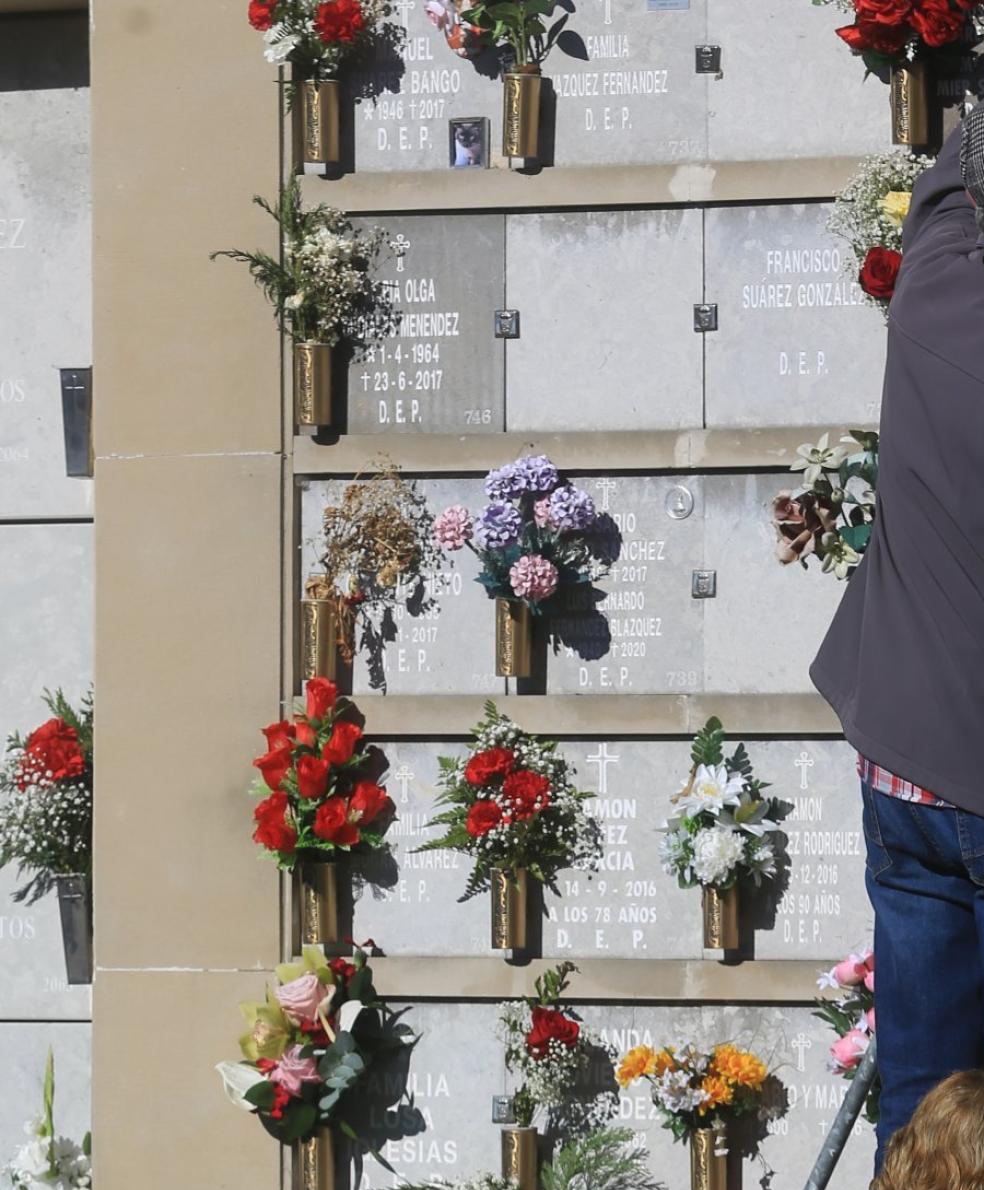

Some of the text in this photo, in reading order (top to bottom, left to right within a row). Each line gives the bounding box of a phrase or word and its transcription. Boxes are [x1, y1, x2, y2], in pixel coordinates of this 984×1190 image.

[587, 35, 629, 58] FAMILIA
[411, 70, 460, 94] BANGO
[603, 71, 668, 95] FERNANDEZ
[378, 100, 445, 120] 1946 2017
[766, 249, 840, 273] FRANCISCO
[405, 279, 435, 302] OLGA
[400, 312, 459, 338] MENENDEZ
[411, 343, 439, 363] 1964
[374, 370, 442, 391] 23 2017
[464, 409, 492, 425] 746
[622, 566, 647, 581] 2017
[413, 626, 438, 643] 2017
[621, 642, 645, 657] 2020
[804, 832, 860, 855] RODRIGUEZ
[800, 866, 838, 884] 12 2016
[566, 881, 656, 897] 14 2016
[814, 890, 841, 914] AÑOS
[564, 903, 657, 923] LOS 78 AÑOS
